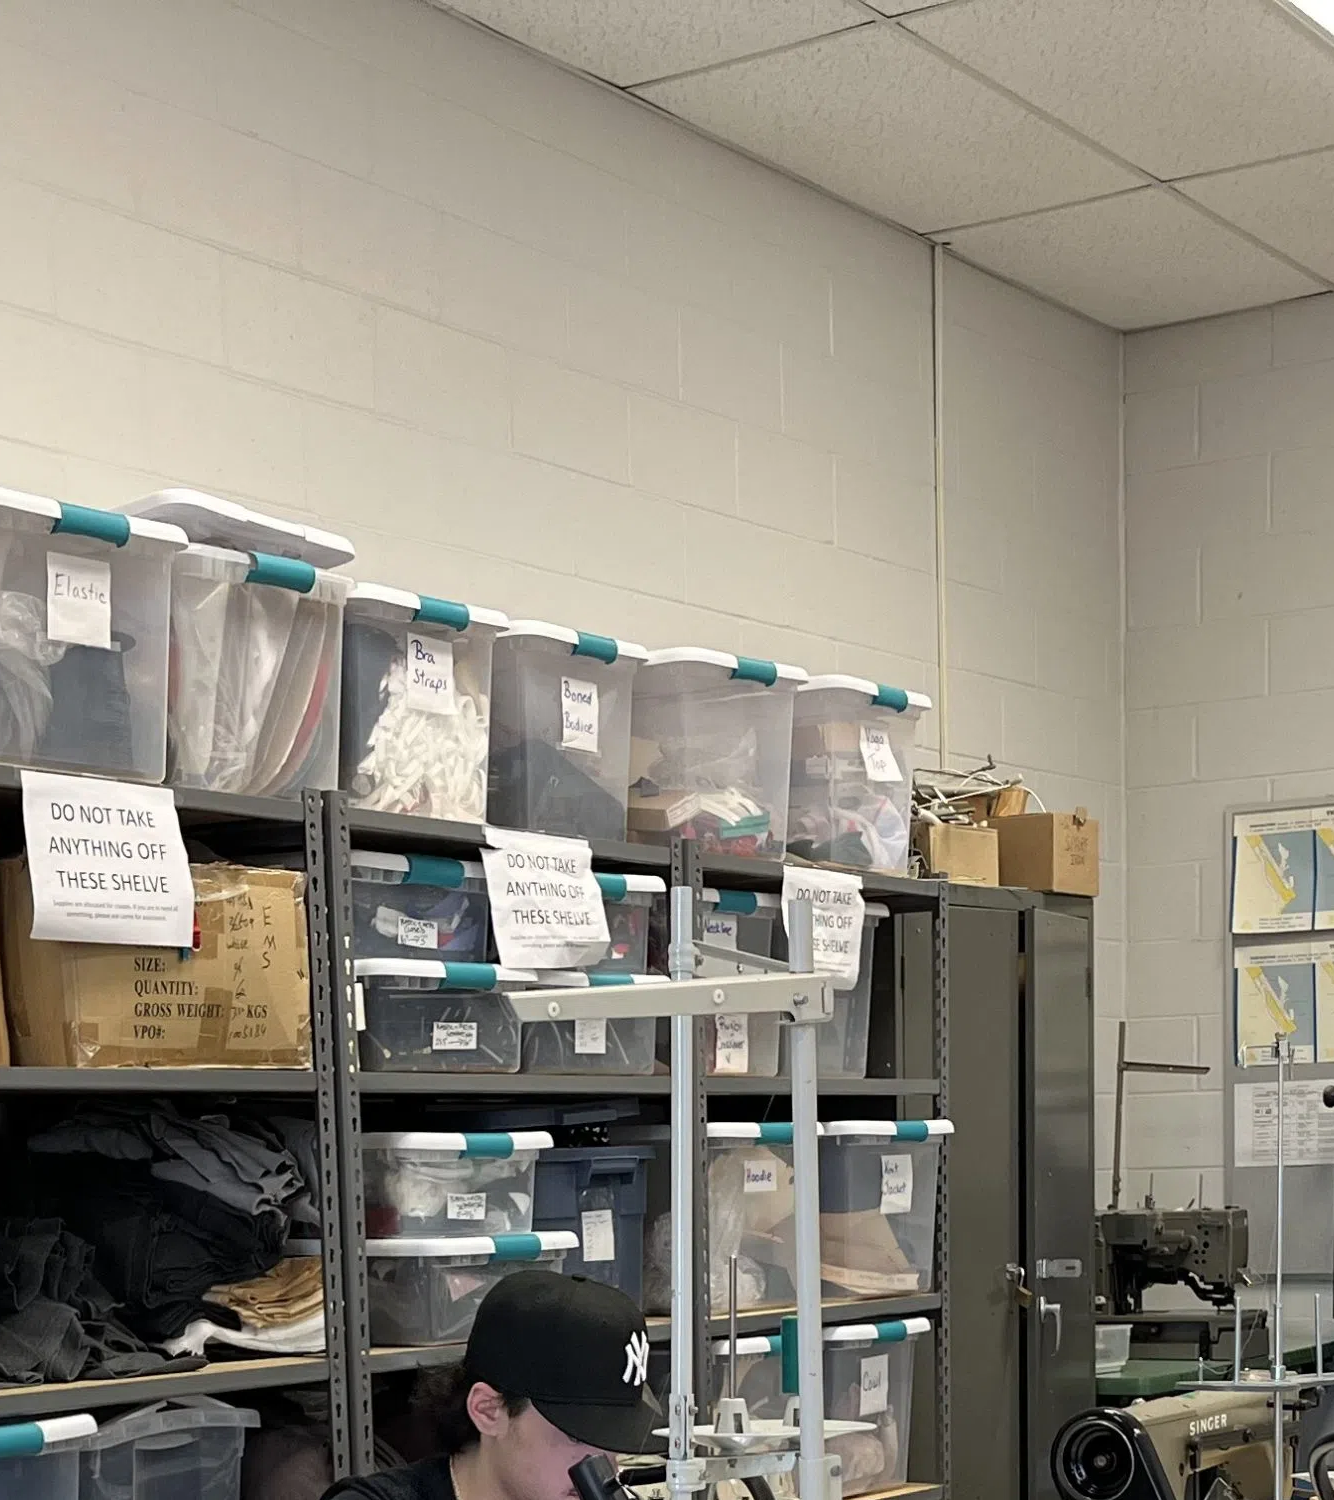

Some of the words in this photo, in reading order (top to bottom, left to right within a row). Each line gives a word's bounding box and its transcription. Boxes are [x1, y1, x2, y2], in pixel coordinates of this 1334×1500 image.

[53, 572, 108, 604] Elastic
[410, 639, 436, 665] Bra
[413, 668, 448, 694] Straps
[51, 802, 75, 821] DO
[80, 805, 112, 824] NOT
[116, 808, 156, 828] TAKE
[49, 836, 133, 859] ANYTHING
[137, 843, 167, 861] OFF
[507, 853, 525, 869] DO
[527, 855, 549, 870] NOT
[552, 857, 576, 873] TAKE
[56, 870, 107, 890] THESE
[112, 873, 170, 893] SHELVE
[507, 882, 567, 898] ANYTHING
[568, 885, 585, 899] OFF
[797, 888, 811, 900] DO
[812, 890, 830, 903] NOT
[833, 892, 852, 905] TAKE
[513, 909, 551, 924] THESE
[553, 910, 592, 925] SHELVE
[836, 916, 853, 929] OFF
[134, 957, 166, 973] SIZE:
[134, 979, 199, 996] QUANTITY:
[134, 1002, 172, 1018] GROSS
[177, 1003, 225, 1019] WEIGHT:
[247, 1004, 268, 1019] KGS
[133, 1024, 166, 1040] VPO#:
[622, 1330, 650, 1386] NY
[1189, 1414, 1227, 1436] SINGER
